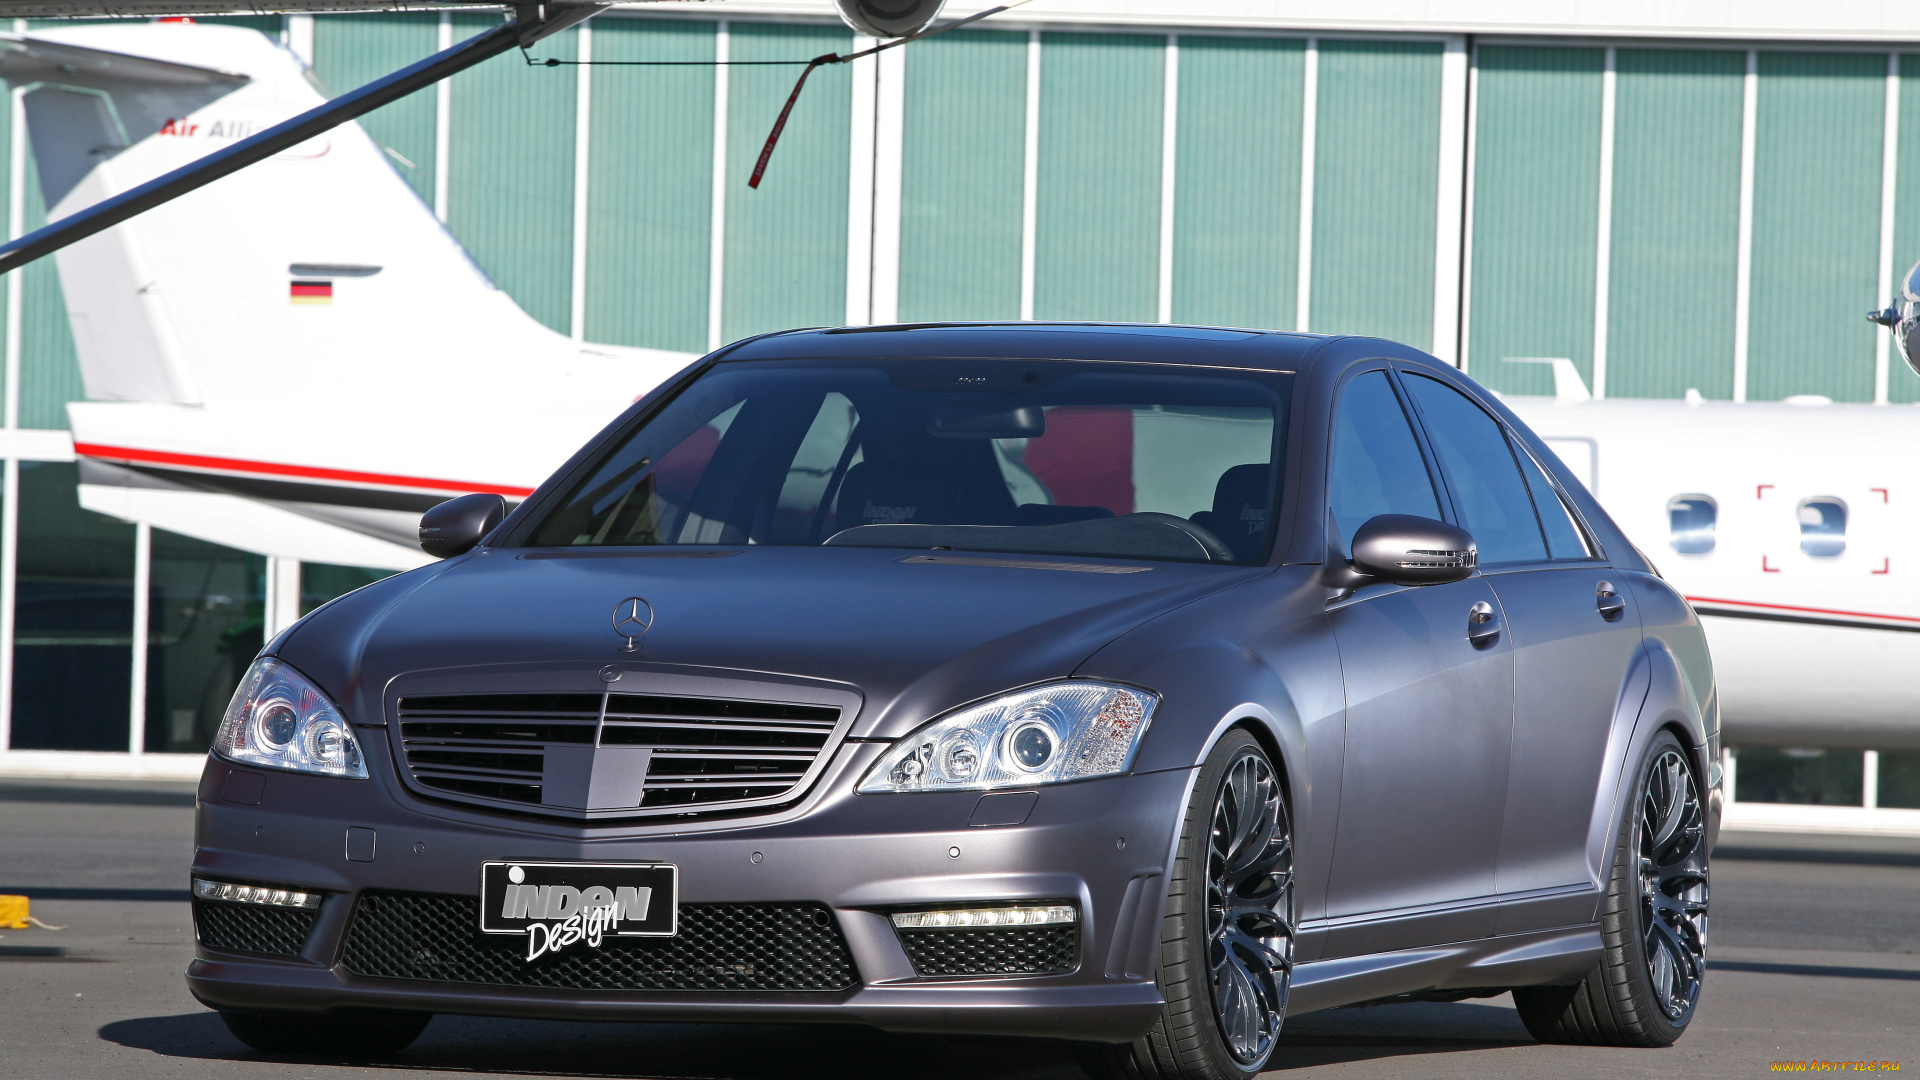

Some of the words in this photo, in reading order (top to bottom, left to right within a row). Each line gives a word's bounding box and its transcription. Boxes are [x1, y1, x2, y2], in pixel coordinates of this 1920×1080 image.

[158, 117, 200, 137] Air
[207, 119, 264, 138] Alli
[754, 142, 774, 177] FLIGHT
[526, 901, 619, 962] Design
